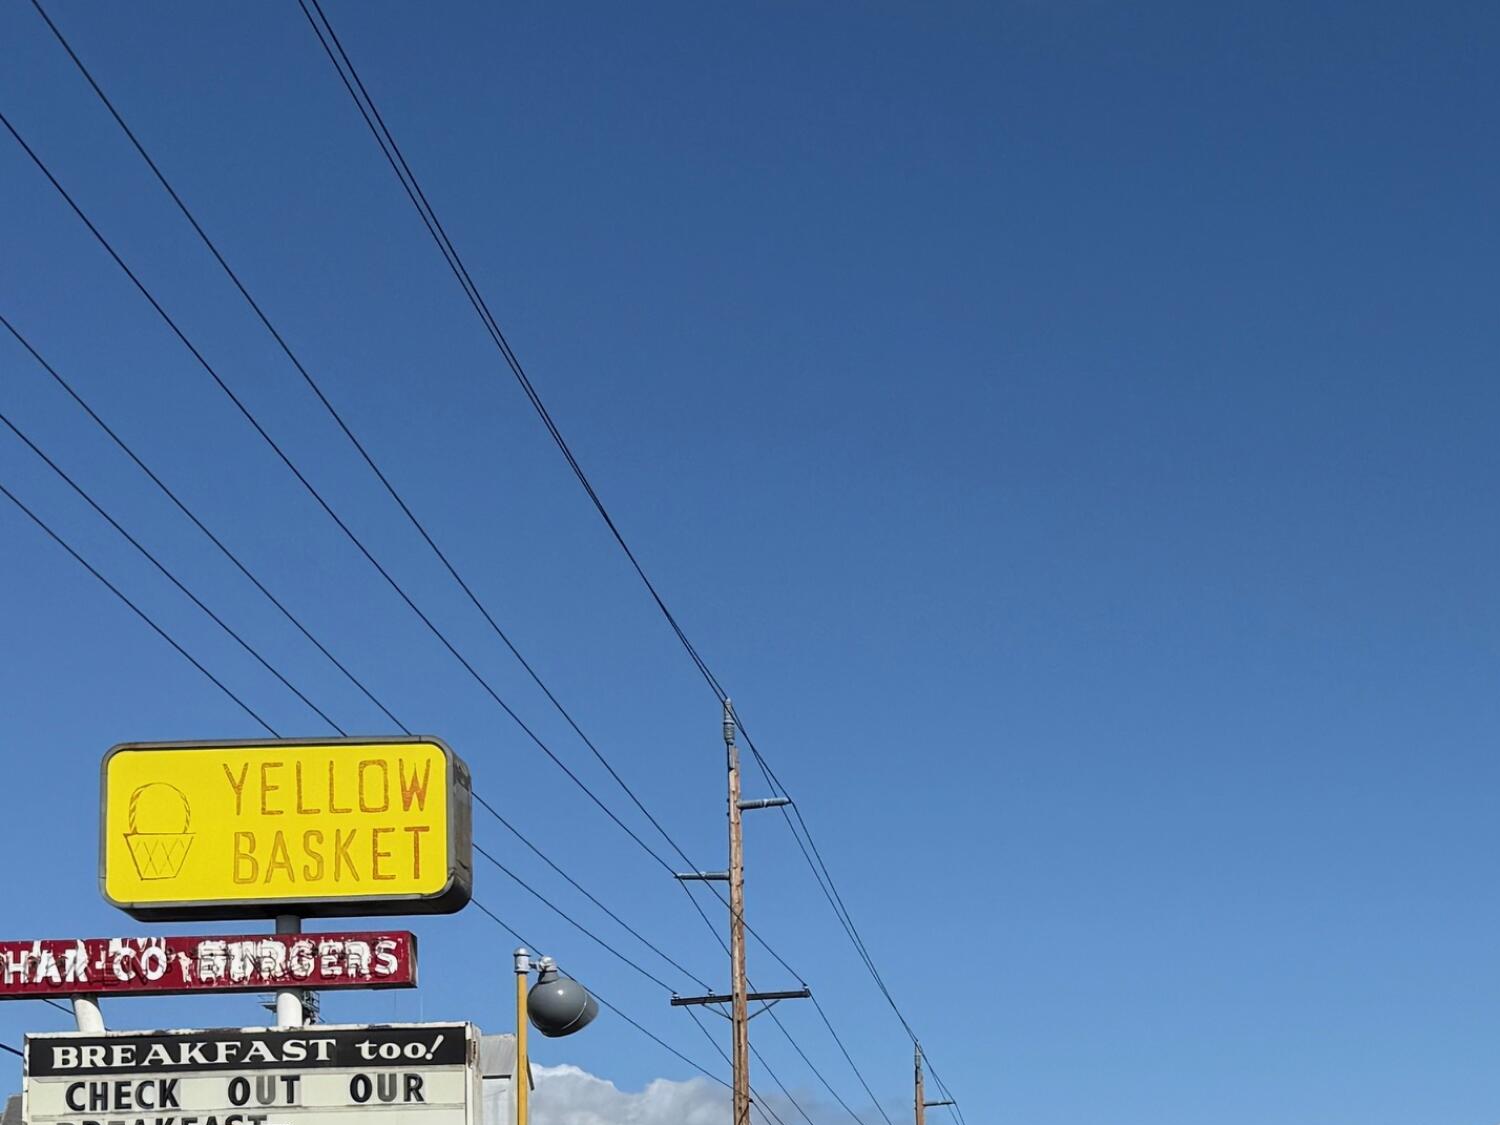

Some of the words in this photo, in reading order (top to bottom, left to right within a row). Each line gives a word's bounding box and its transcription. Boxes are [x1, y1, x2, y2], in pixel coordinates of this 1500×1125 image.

[222, 758, 431, 816] YELLOW
[233, 826, 430, 884] BASKET
[0, 944, 168, 984] HAR-CO
[198, 940, 397, 981] BURGERS
[52, 1039, 337, 1069] BREAKFAST
[355, 1034, 444, 1061] too!
[65, 1078, 180, 1111] CHECK
[227, 1075, 299, 1106] OUT
[350, 1073, 424, 1103] OUR
